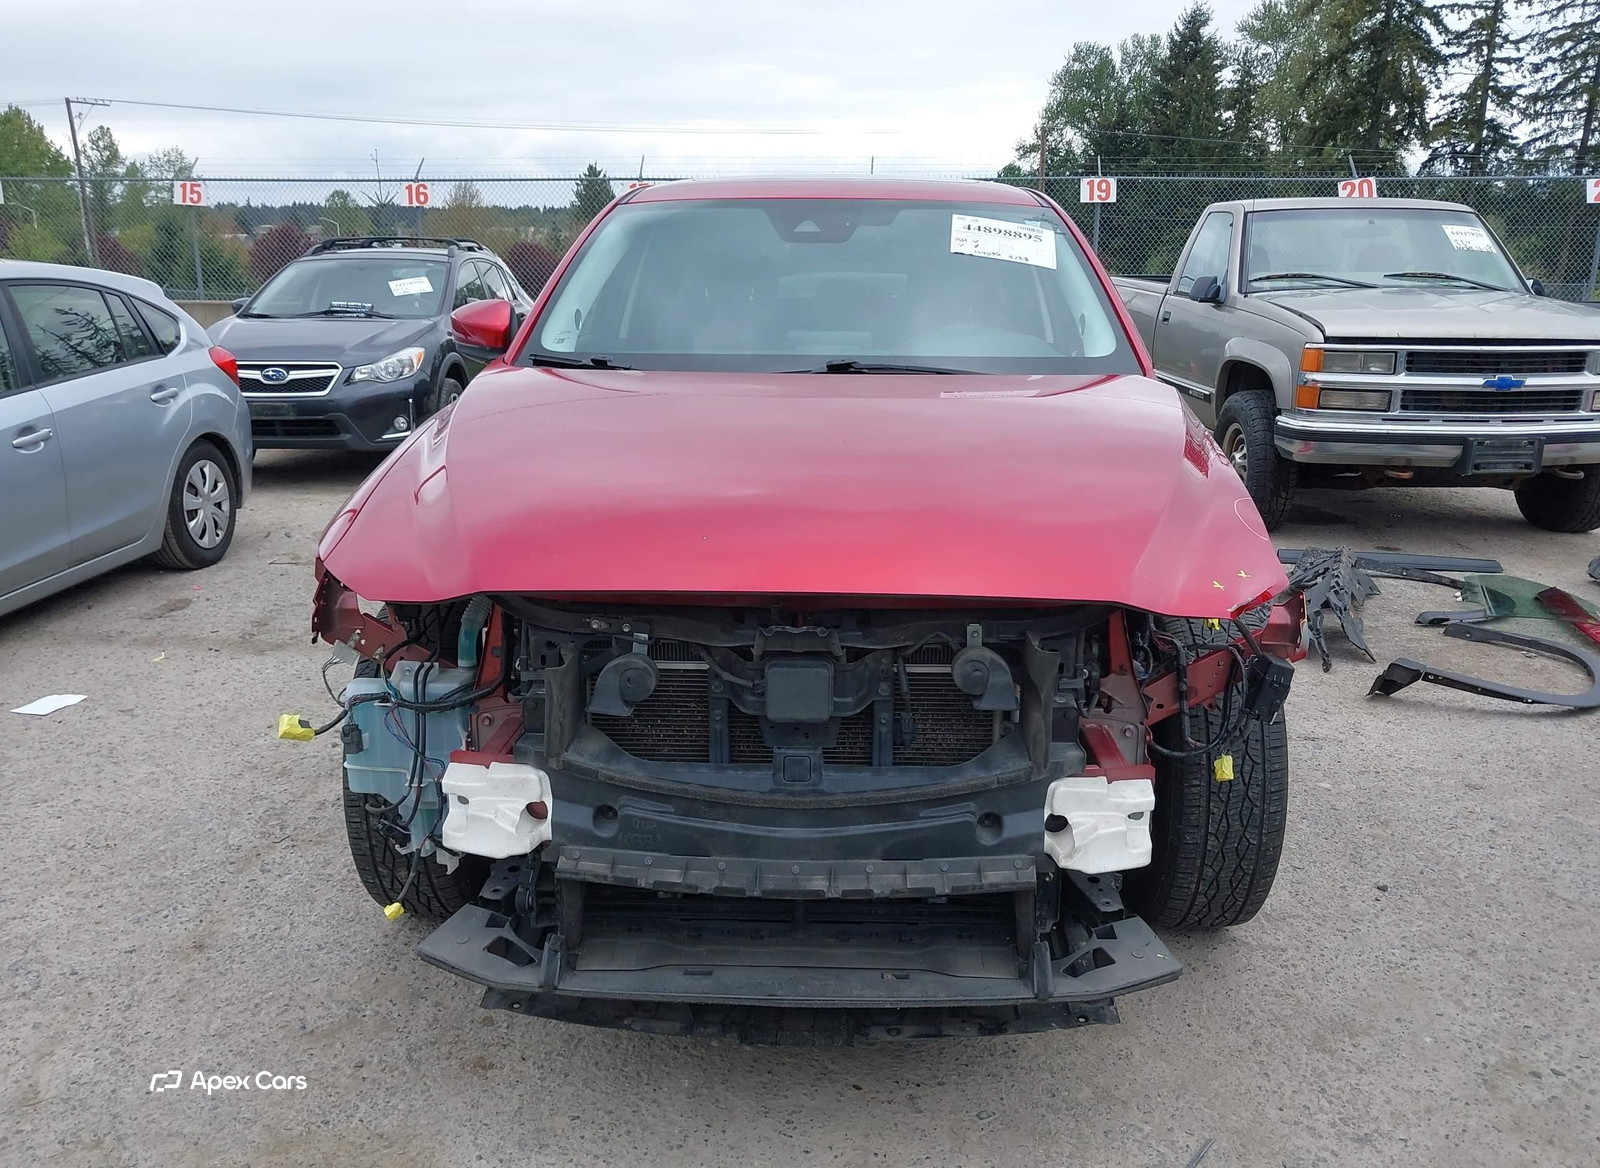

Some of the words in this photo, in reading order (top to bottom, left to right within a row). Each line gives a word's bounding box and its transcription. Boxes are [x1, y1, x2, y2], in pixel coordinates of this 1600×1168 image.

[180, 182, 202, 204] 15
[405, 183, 429, 205] 16
[1086, 179, 1111, 201] 19
[1341, 179, 1374, 198] 20
[962, 223, 1043, 243] 44898895
